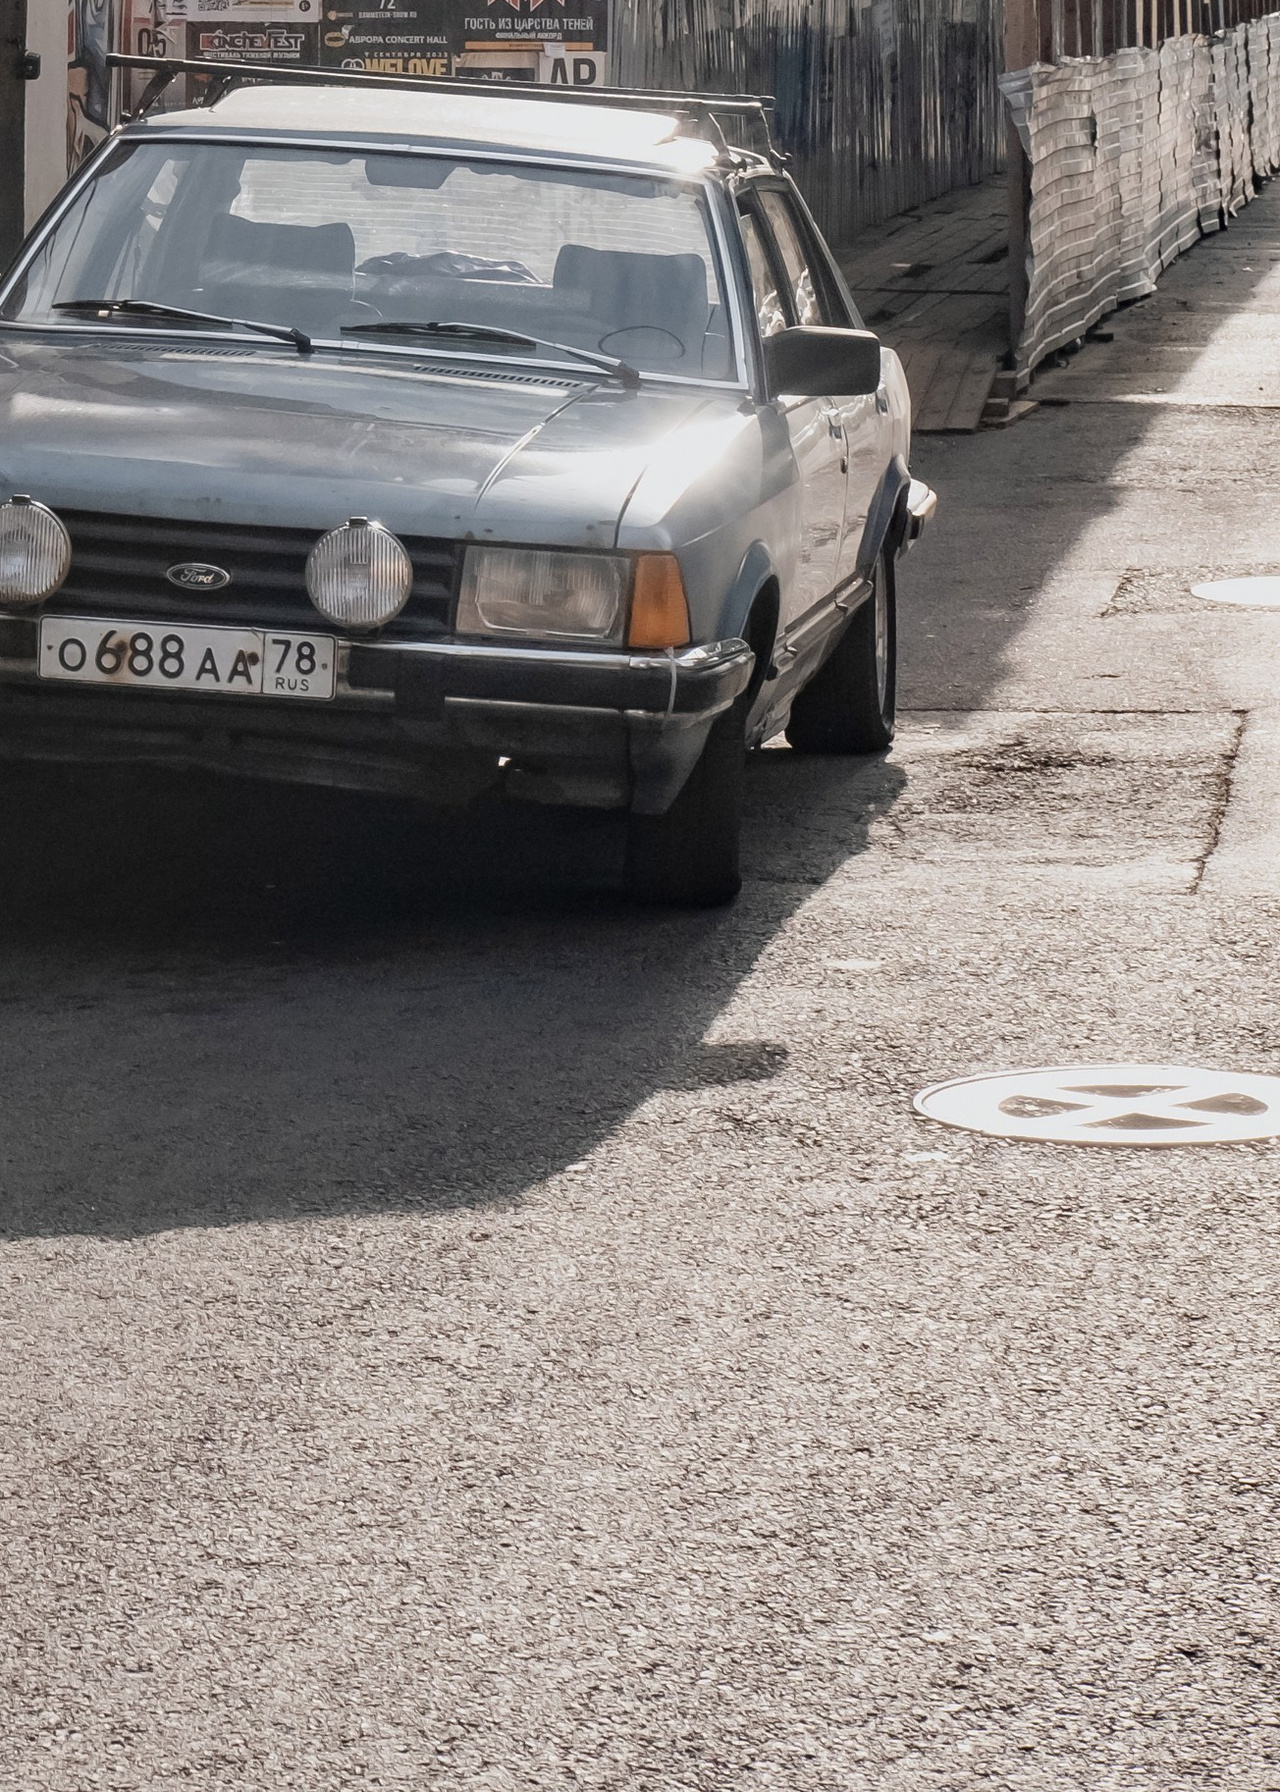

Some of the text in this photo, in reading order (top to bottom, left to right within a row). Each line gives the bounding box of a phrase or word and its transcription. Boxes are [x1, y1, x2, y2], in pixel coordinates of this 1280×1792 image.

[464, 16, 594, 32] ГОСТЬ ИЗ ЦАРСТВА ТЕНЕЙ
[348, 35, 448, 44] АВРОРА CONCERT HALL
[179, 566, 216, 585] Ford
[271, 638, 317, 676] 78
[274, 676, 310, 692] RUS
